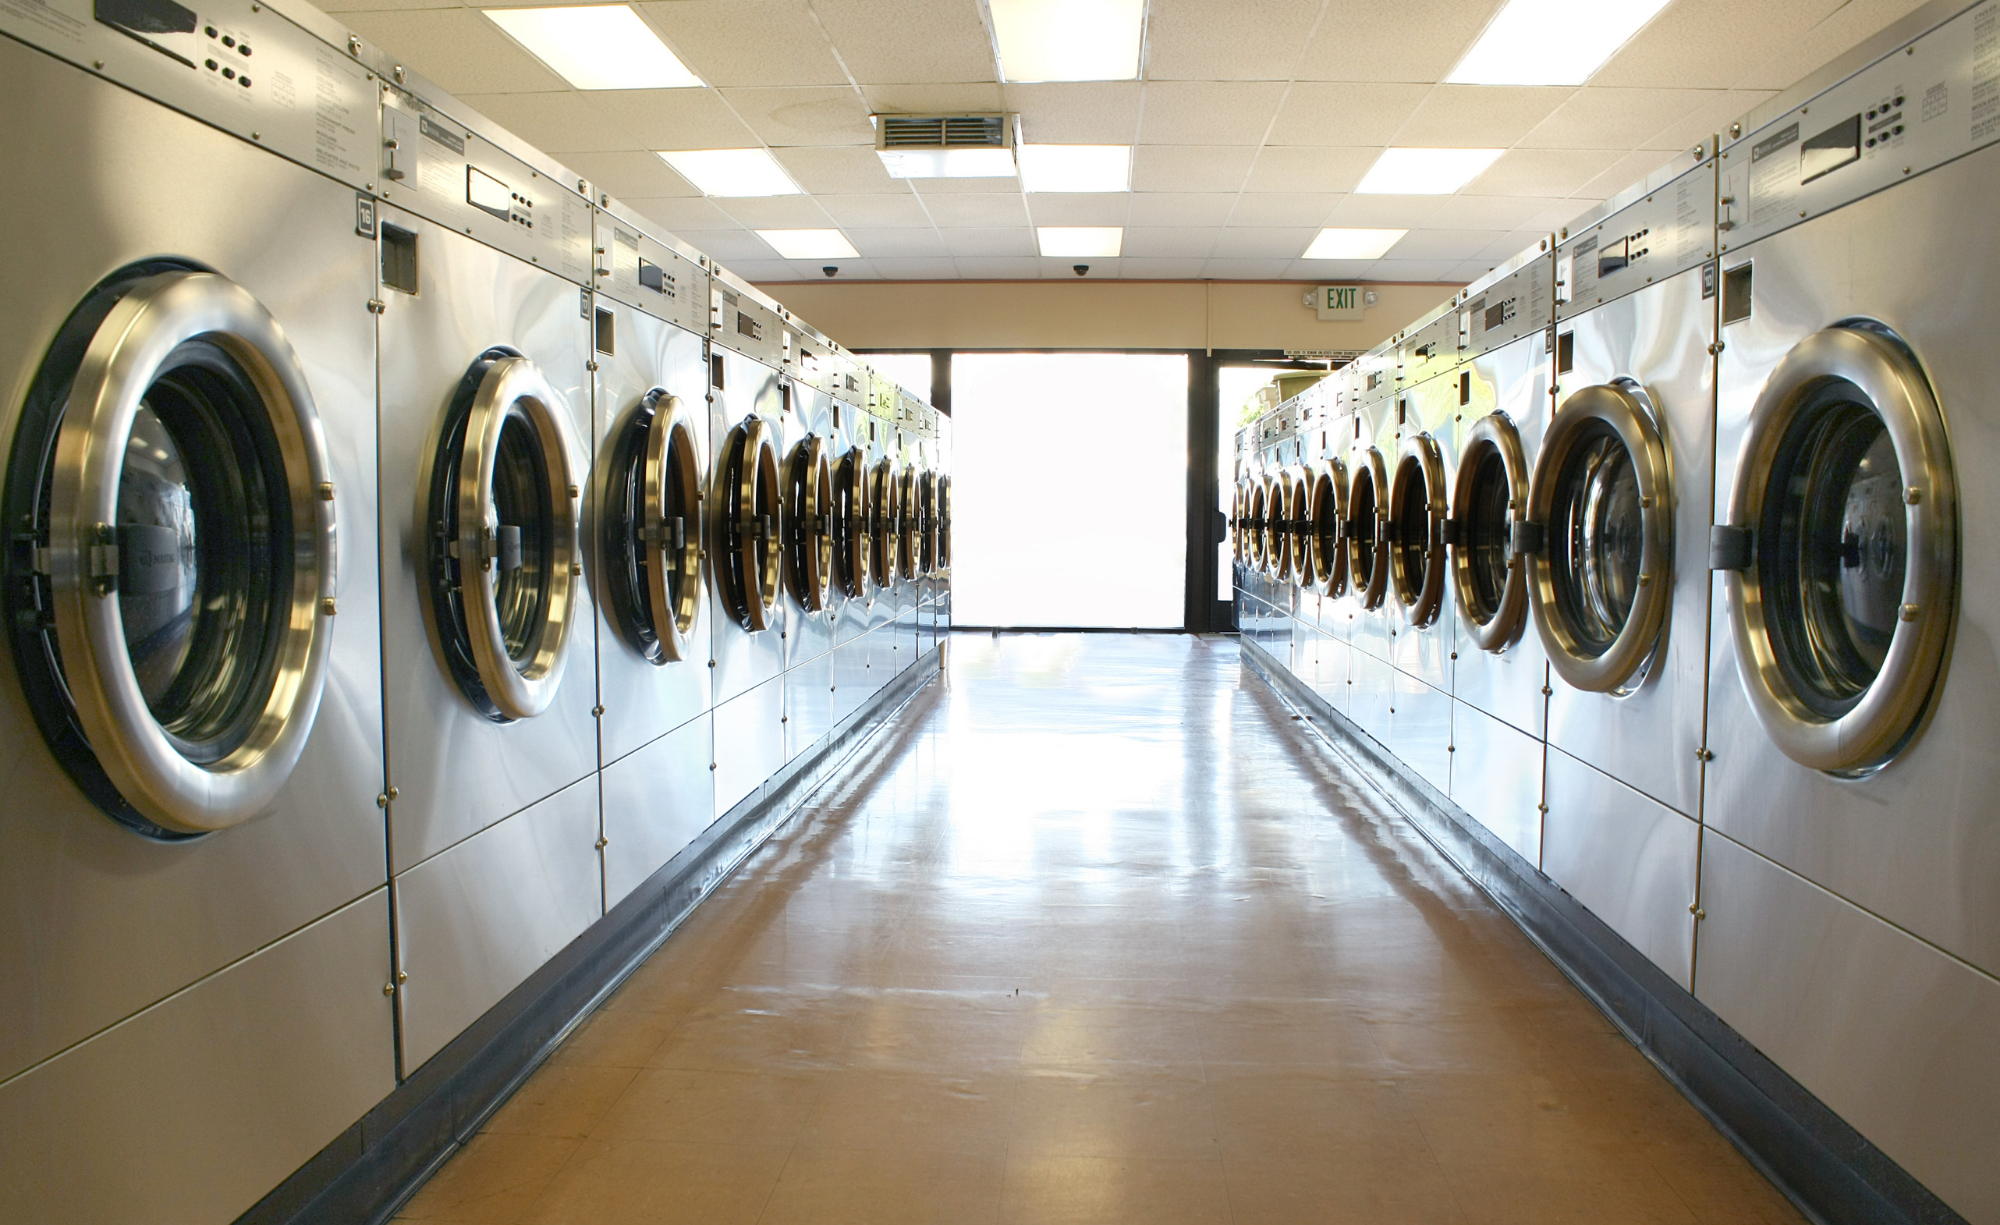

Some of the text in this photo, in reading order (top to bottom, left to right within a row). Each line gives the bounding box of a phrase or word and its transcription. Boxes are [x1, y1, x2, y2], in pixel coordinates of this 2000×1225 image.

[361, 208, 371, 225] 16
[1705, 274, 1711, 287] 10
[1327, 288, 1356, 309] EXIT
